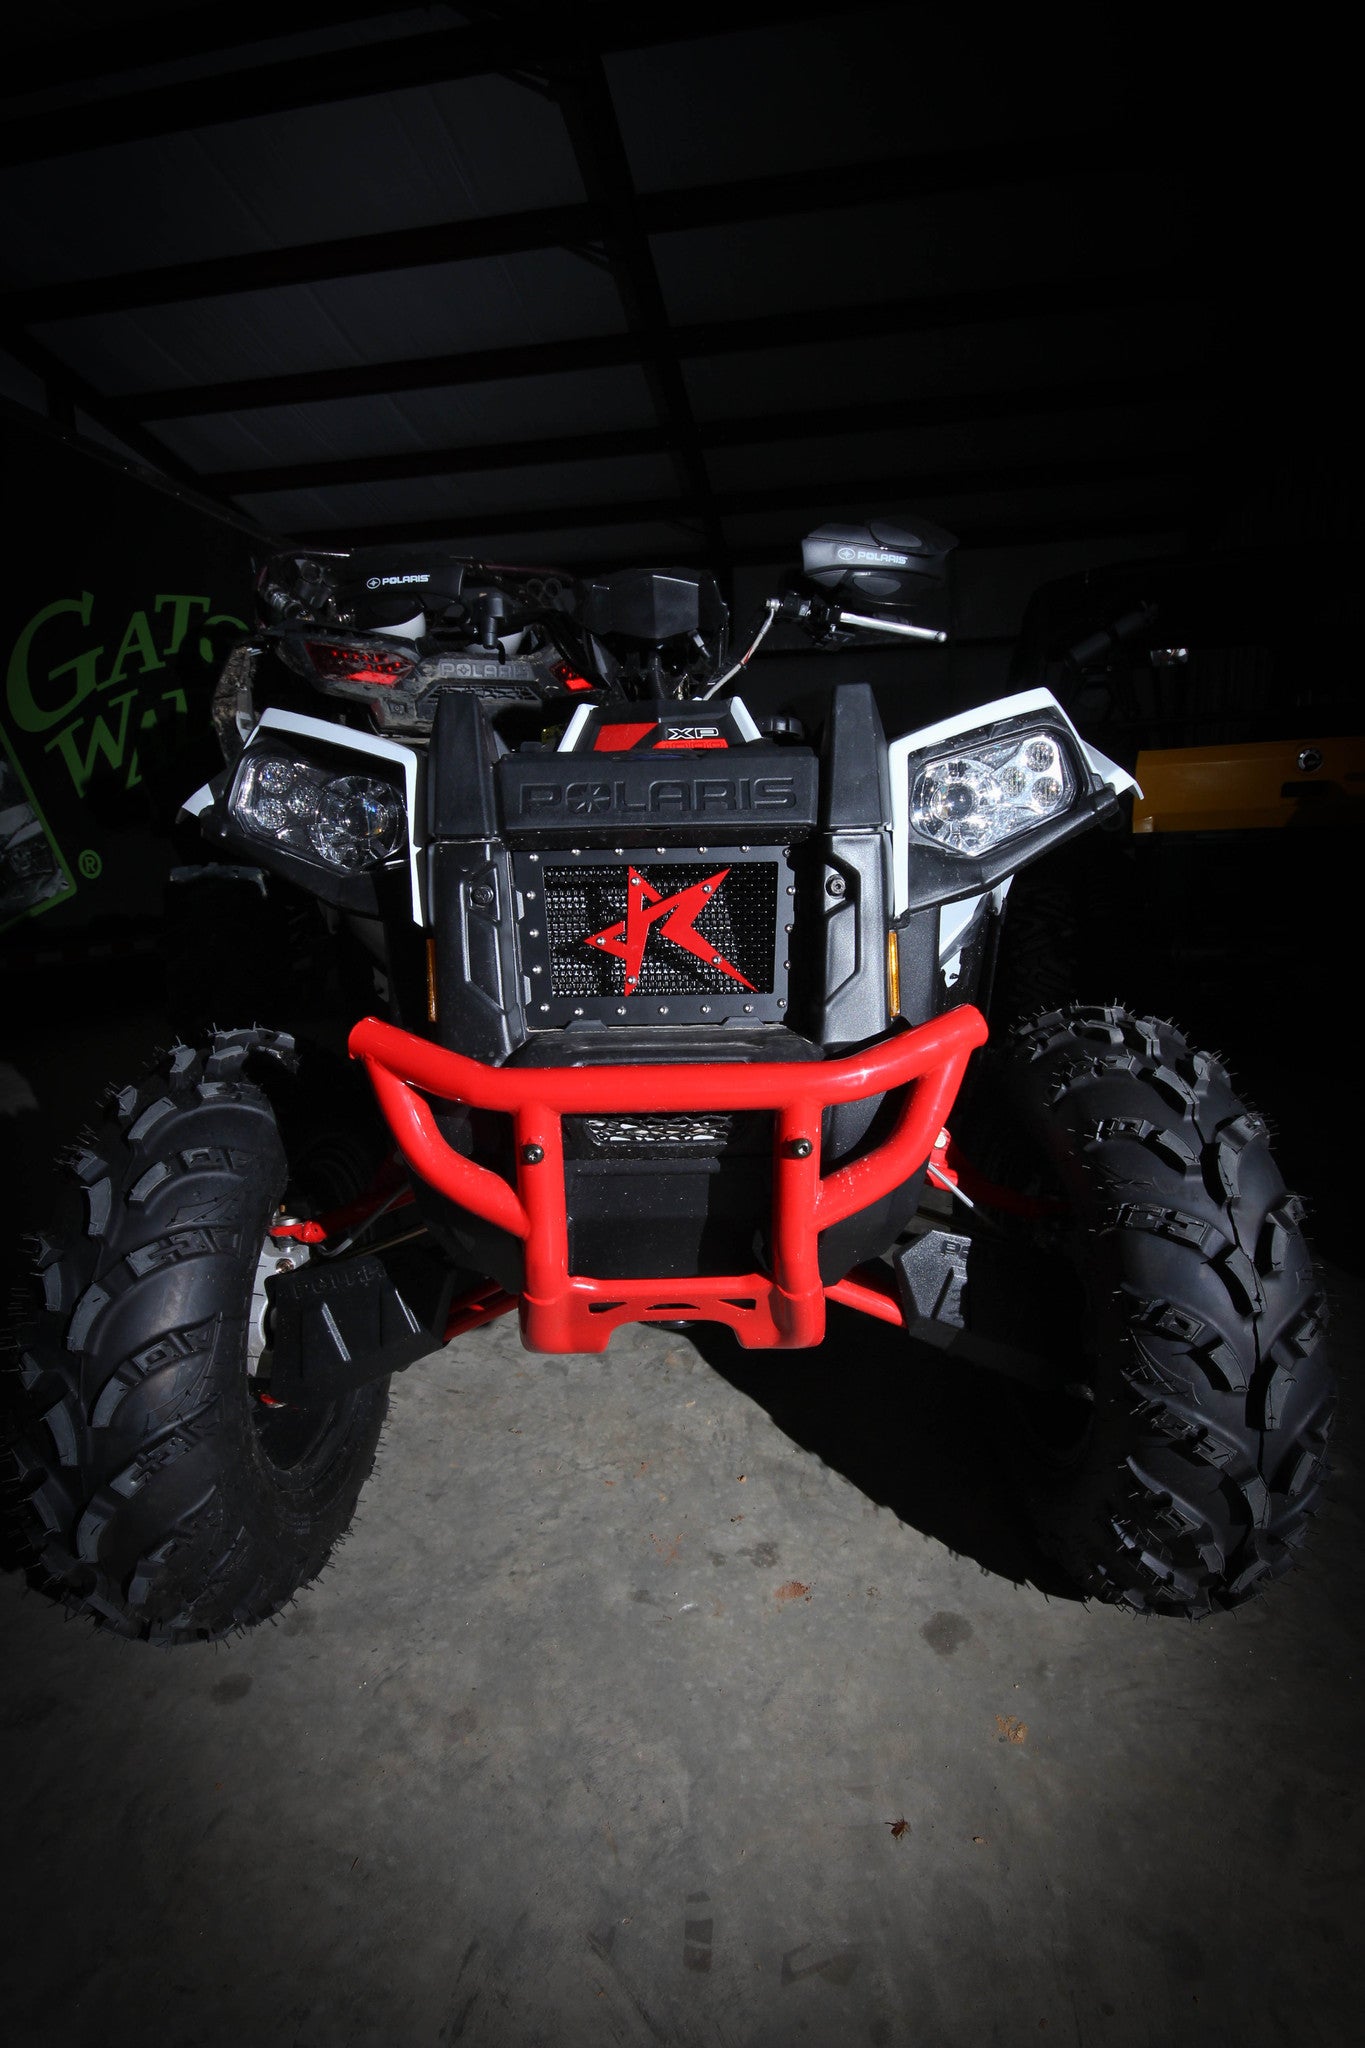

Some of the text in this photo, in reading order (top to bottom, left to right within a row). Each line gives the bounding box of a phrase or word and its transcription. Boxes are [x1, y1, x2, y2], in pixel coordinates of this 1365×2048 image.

[858, 551, 908, 565] POLARIS
[382, 574, 430, 586] POLARIS
[668, 727, 719, 740] XP
[519, 777, 797, 815] POLARIS
